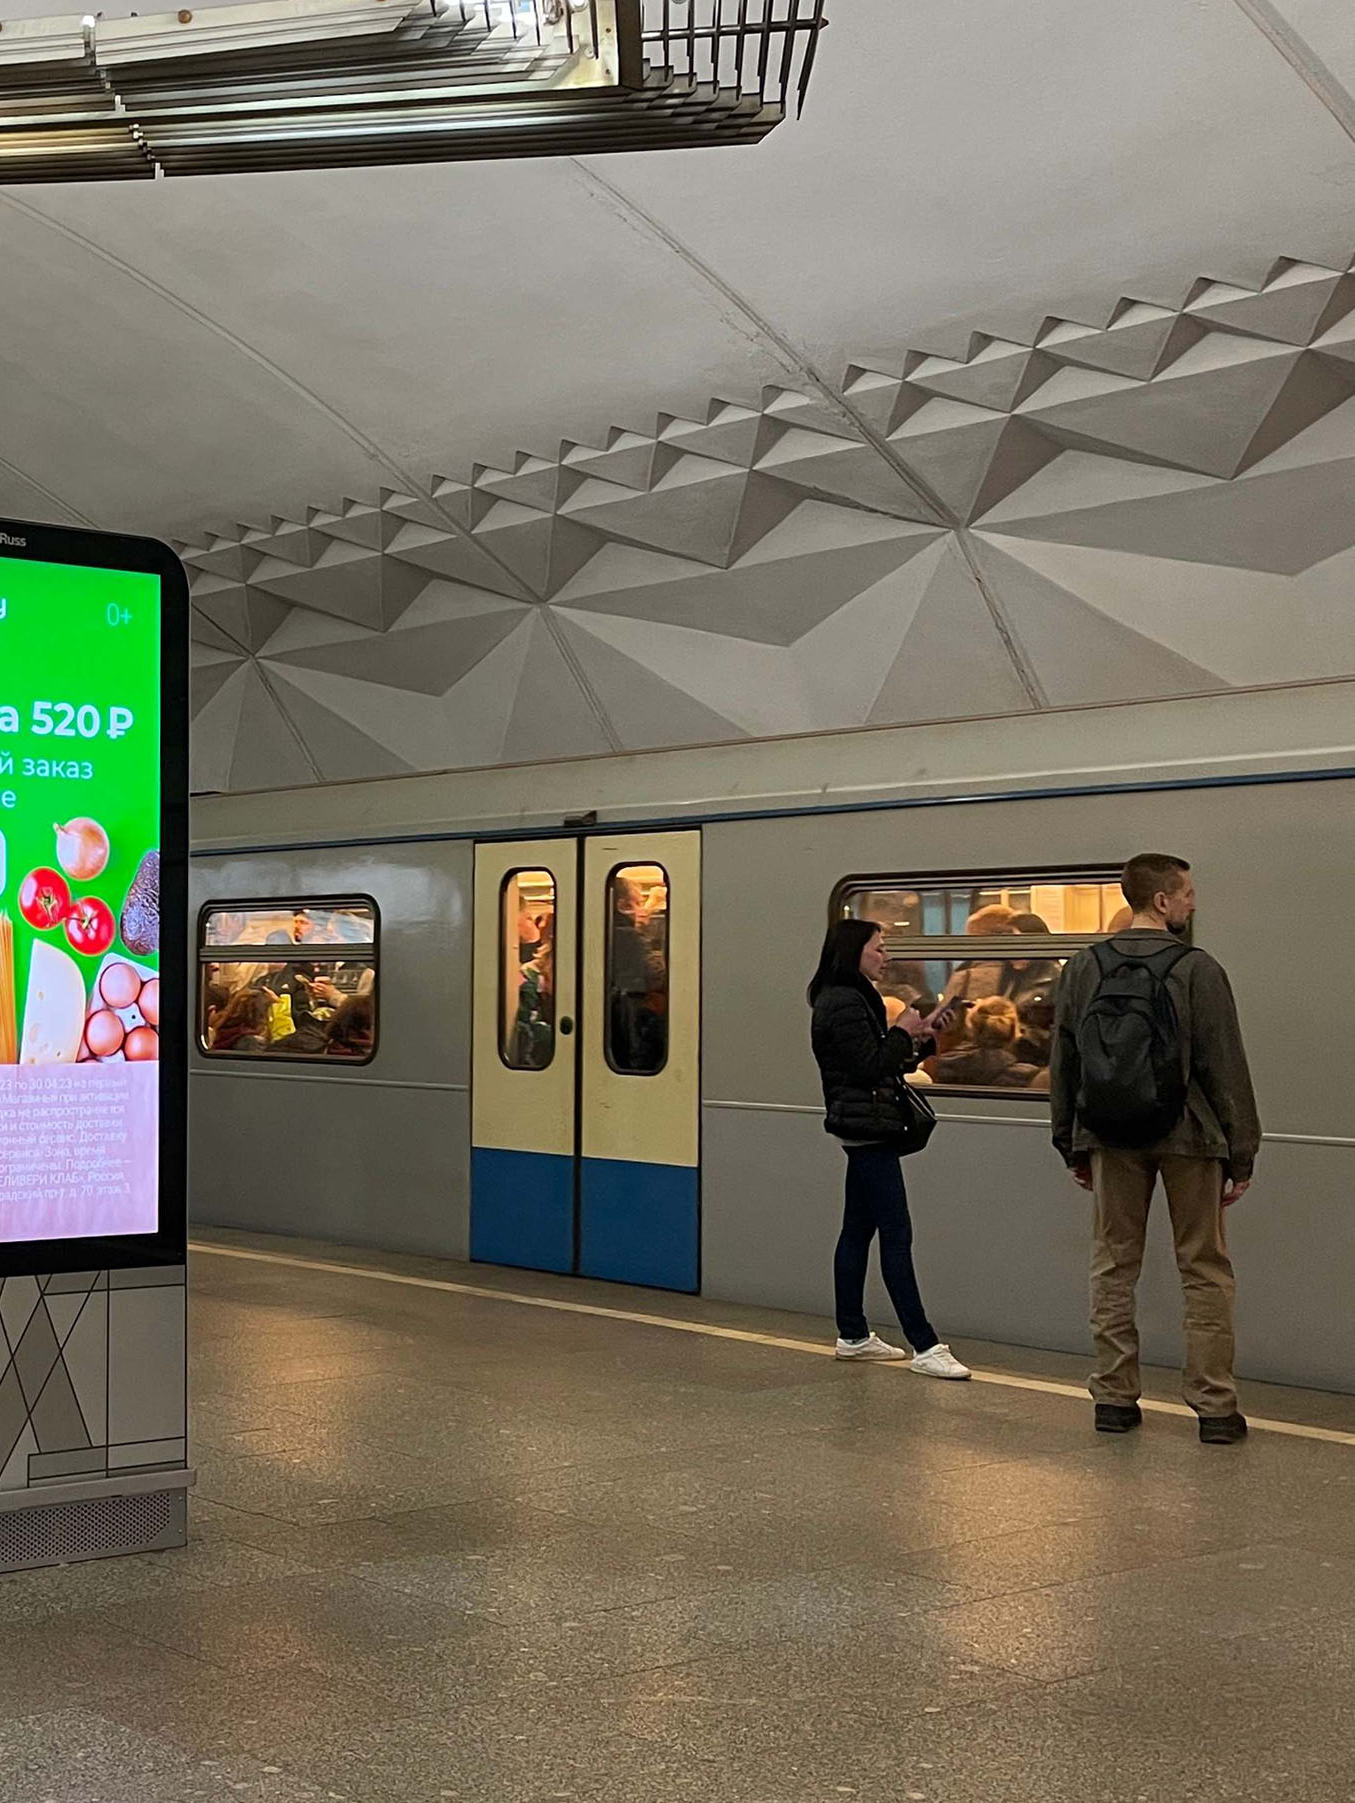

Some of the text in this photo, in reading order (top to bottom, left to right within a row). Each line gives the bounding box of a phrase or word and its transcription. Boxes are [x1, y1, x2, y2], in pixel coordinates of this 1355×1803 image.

[0, 532, 26, 547] Russ
[106, 603, 132, 627] 0+
[31, 701, 100, 739] 520
[22, 759, 93, 780] заказ
